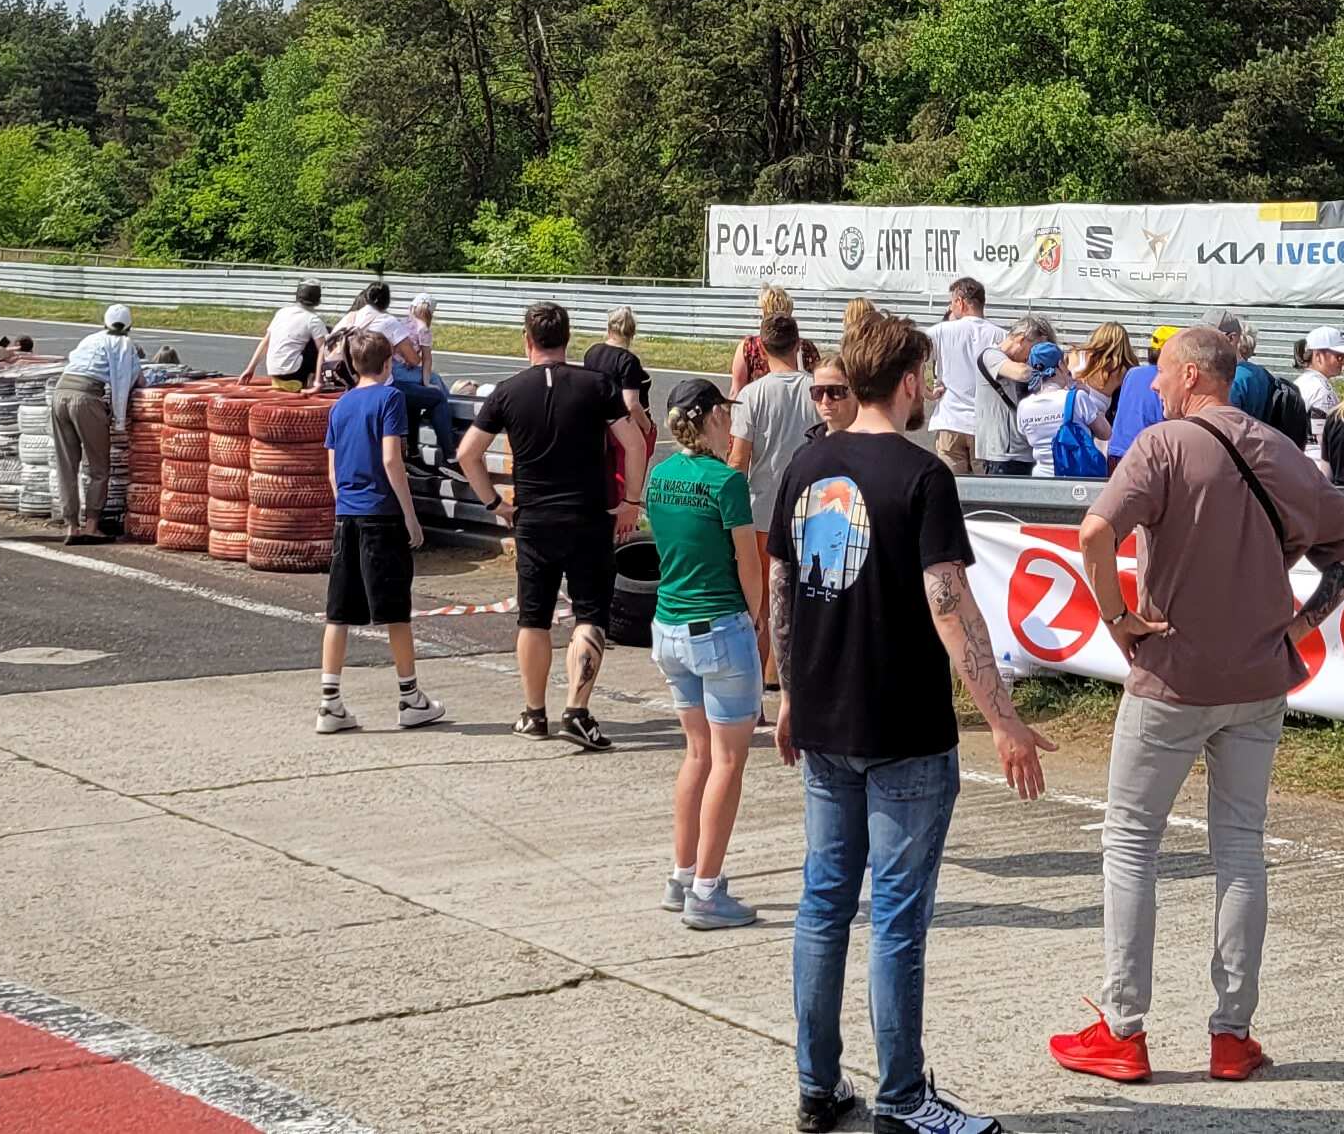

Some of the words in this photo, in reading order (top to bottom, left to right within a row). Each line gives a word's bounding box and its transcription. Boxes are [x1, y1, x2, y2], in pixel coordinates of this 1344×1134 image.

[716, 223, 828, 257] POL-CAR
[876, 228, 912, 271] FIAT
[924, 229, 960, 272] FIAT
[973, 238, 1020, 267] Jeep
[1078, 266, 1120, 279] SEAT
[1129, 272, 1187, 282] CUPRA
